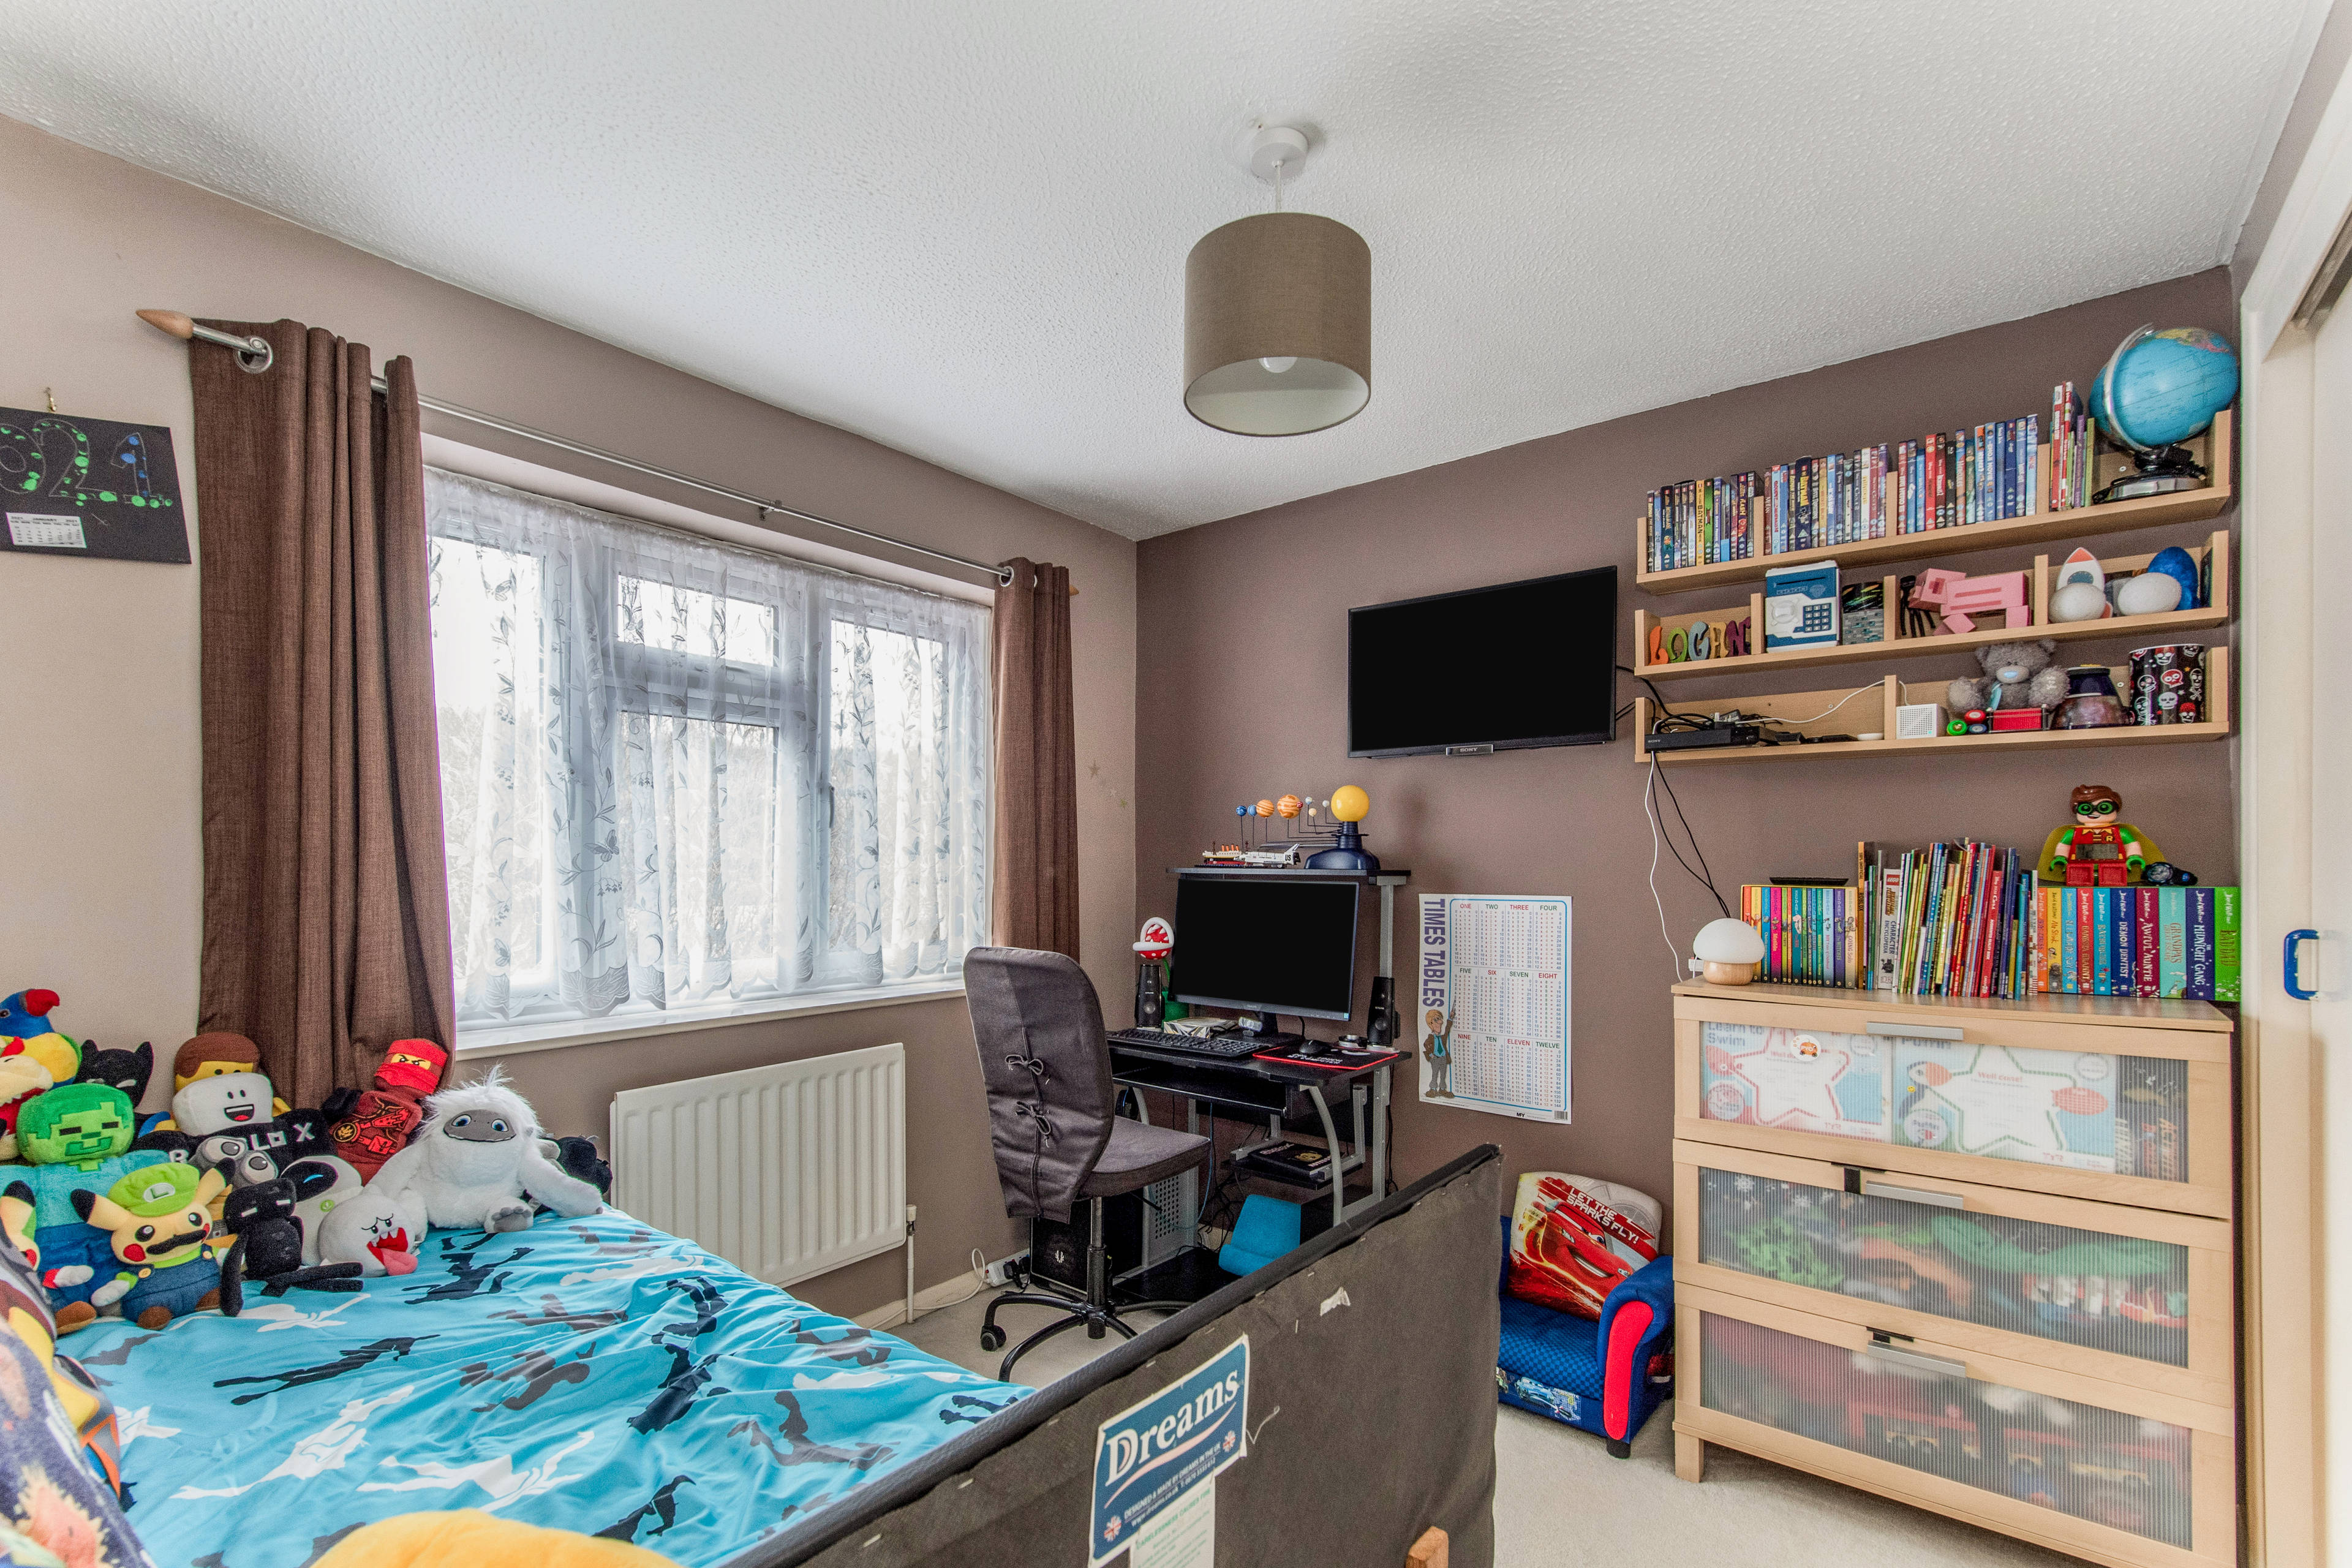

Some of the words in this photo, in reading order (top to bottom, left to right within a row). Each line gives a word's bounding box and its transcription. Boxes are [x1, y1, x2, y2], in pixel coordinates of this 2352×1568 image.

[1649, 616, 1751, 666] LOGAN
[1423, 898, 1446, 947] TIMES
[2119, 922, 2128, 947] DEMON
[2143, 922, 2154, 951] AWFUL
[2170, 922, 2182, 963] GRANDPA'S
[2194, 925, 2206, 962] MIDNIGHT
[1422, 951, 1446, 1008] TABLES
[2119, 949, 2128, 978] DENTIST
[2143, 952, 2153, 981] AUNTIE
[2194, 964, 2206, 985] GANG
[1707, 1033, 1746, 1046] Swim
[169, 1122, 315, 1163] RLOX
[150, 1188, 169, 1199] L
[1569, 1188, 1593, 1205] LET
[1595, 1201, 1617, 1220] THE
[1567, 1195, 1611, 1227] SPARKS
[1610, 1223, 1639, 1244] FLY!
[1105, 1369, 1240, 1487] Dreams
[1124, 1494, 1153, 1519] DESIGNED
[1179, 1458, 1199, 1479] DREAMS
[1136, 1513, 1178, 1550] CARELESSNESS
[1180, 1497, 1200, 1517] CAUSES
[1200, 1487, 1211, 1501] FIRE
